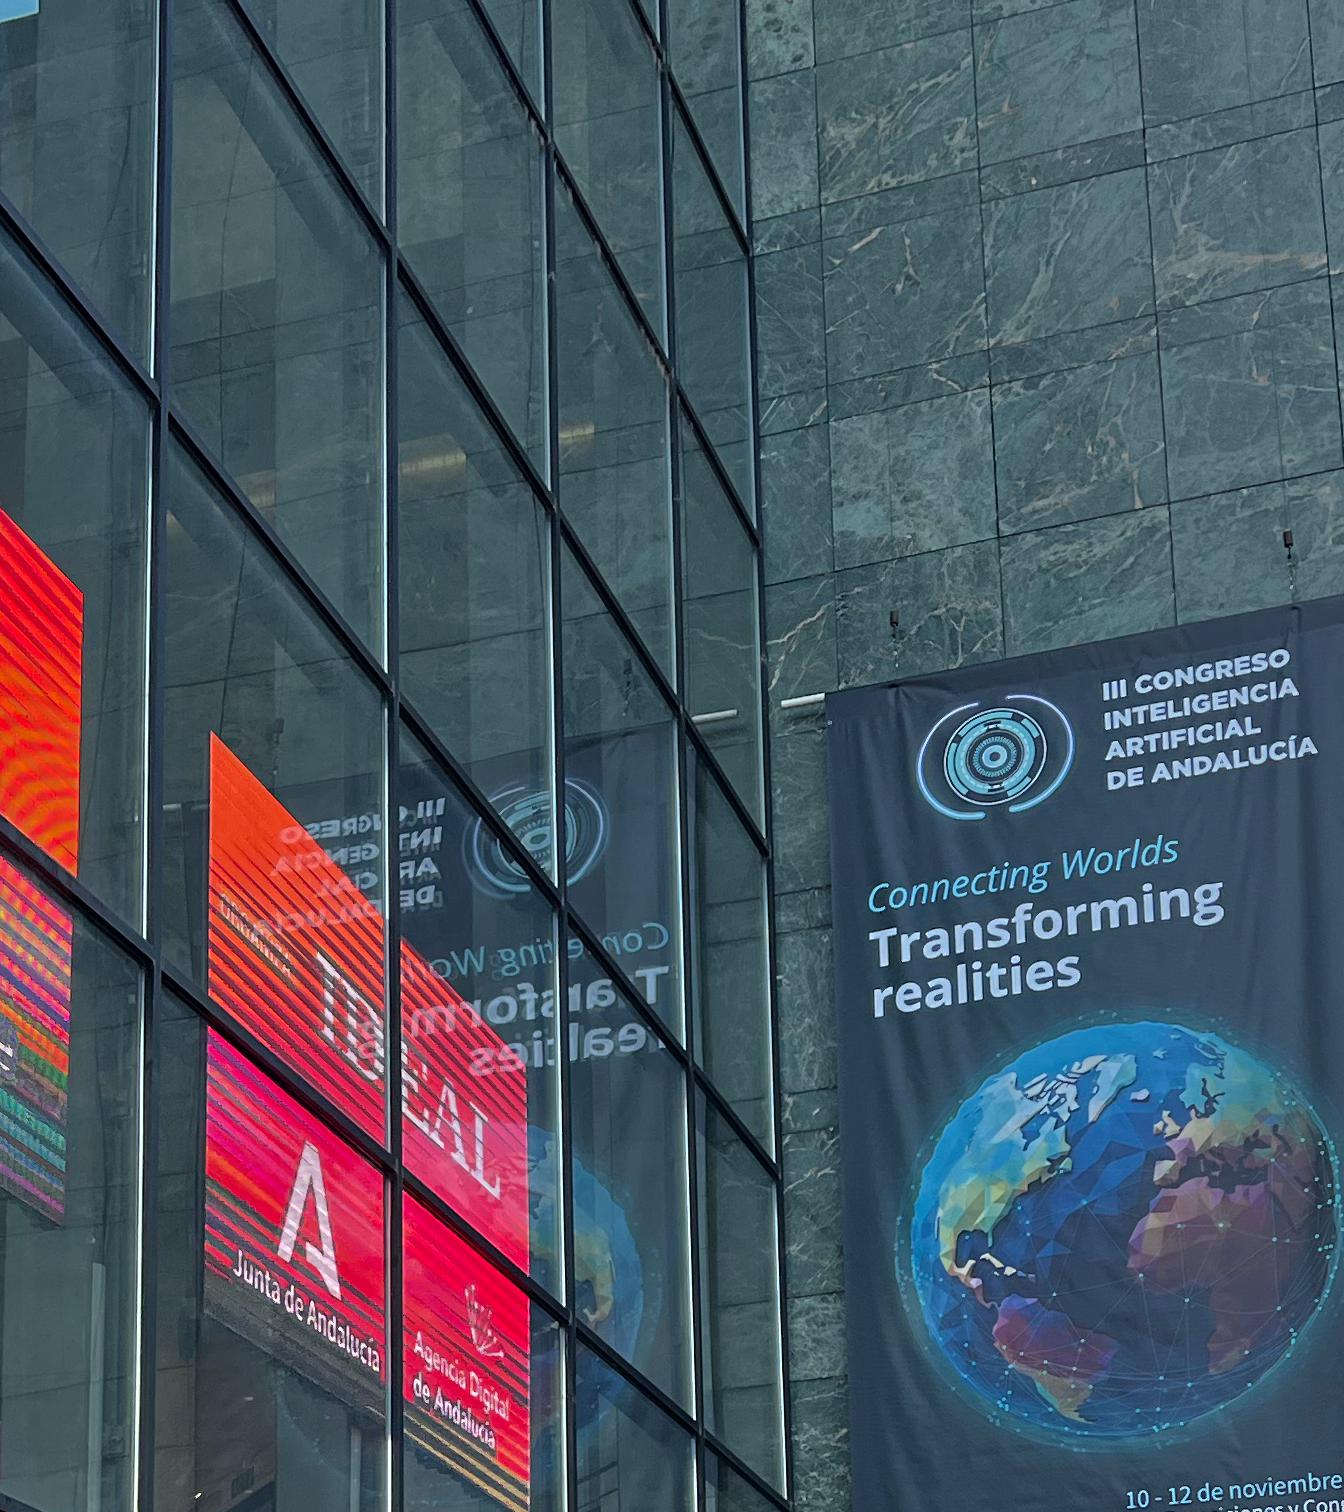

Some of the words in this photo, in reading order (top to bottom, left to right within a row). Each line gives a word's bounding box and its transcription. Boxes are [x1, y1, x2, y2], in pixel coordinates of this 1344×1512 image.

[1102, 679, 1127, 701] III
[1134, 649, 1291, 694] CONGRESO
[1104, 678, 1299, 730] INTELIGENCIA
[1105, 716, 1261, 761] ARTIFICIAL
[1107, 767, 1144, 791] DE
[1151, 735, 1318, 783] ANDALUCÍA
[868, 861, 1051, 913] Connecting
[1061, 834, 1179, 879] Worlds
[868, 881, 1224, 968] Transforming
[872, 955, 1081, 1018] realities
[316, 952, 501, 1201] IDEAL
[233, 1249, 281, 1305] Junta
[284, 1284, 304, 1322] de
[307, 1300, 380, 1372] Andalucía
[413, 1371, 430, 1404] de
[414, 1330, 466, 1390] Agencia
[469, 1371, 509, 1421] Digital
[1126, 1489, 1150, 1509] 10
[1168, 1486, 1192, 1506] 12
[1197, 1482, 1224, 1504] de
[1228, 1472, 1343, 1500] noviembre
